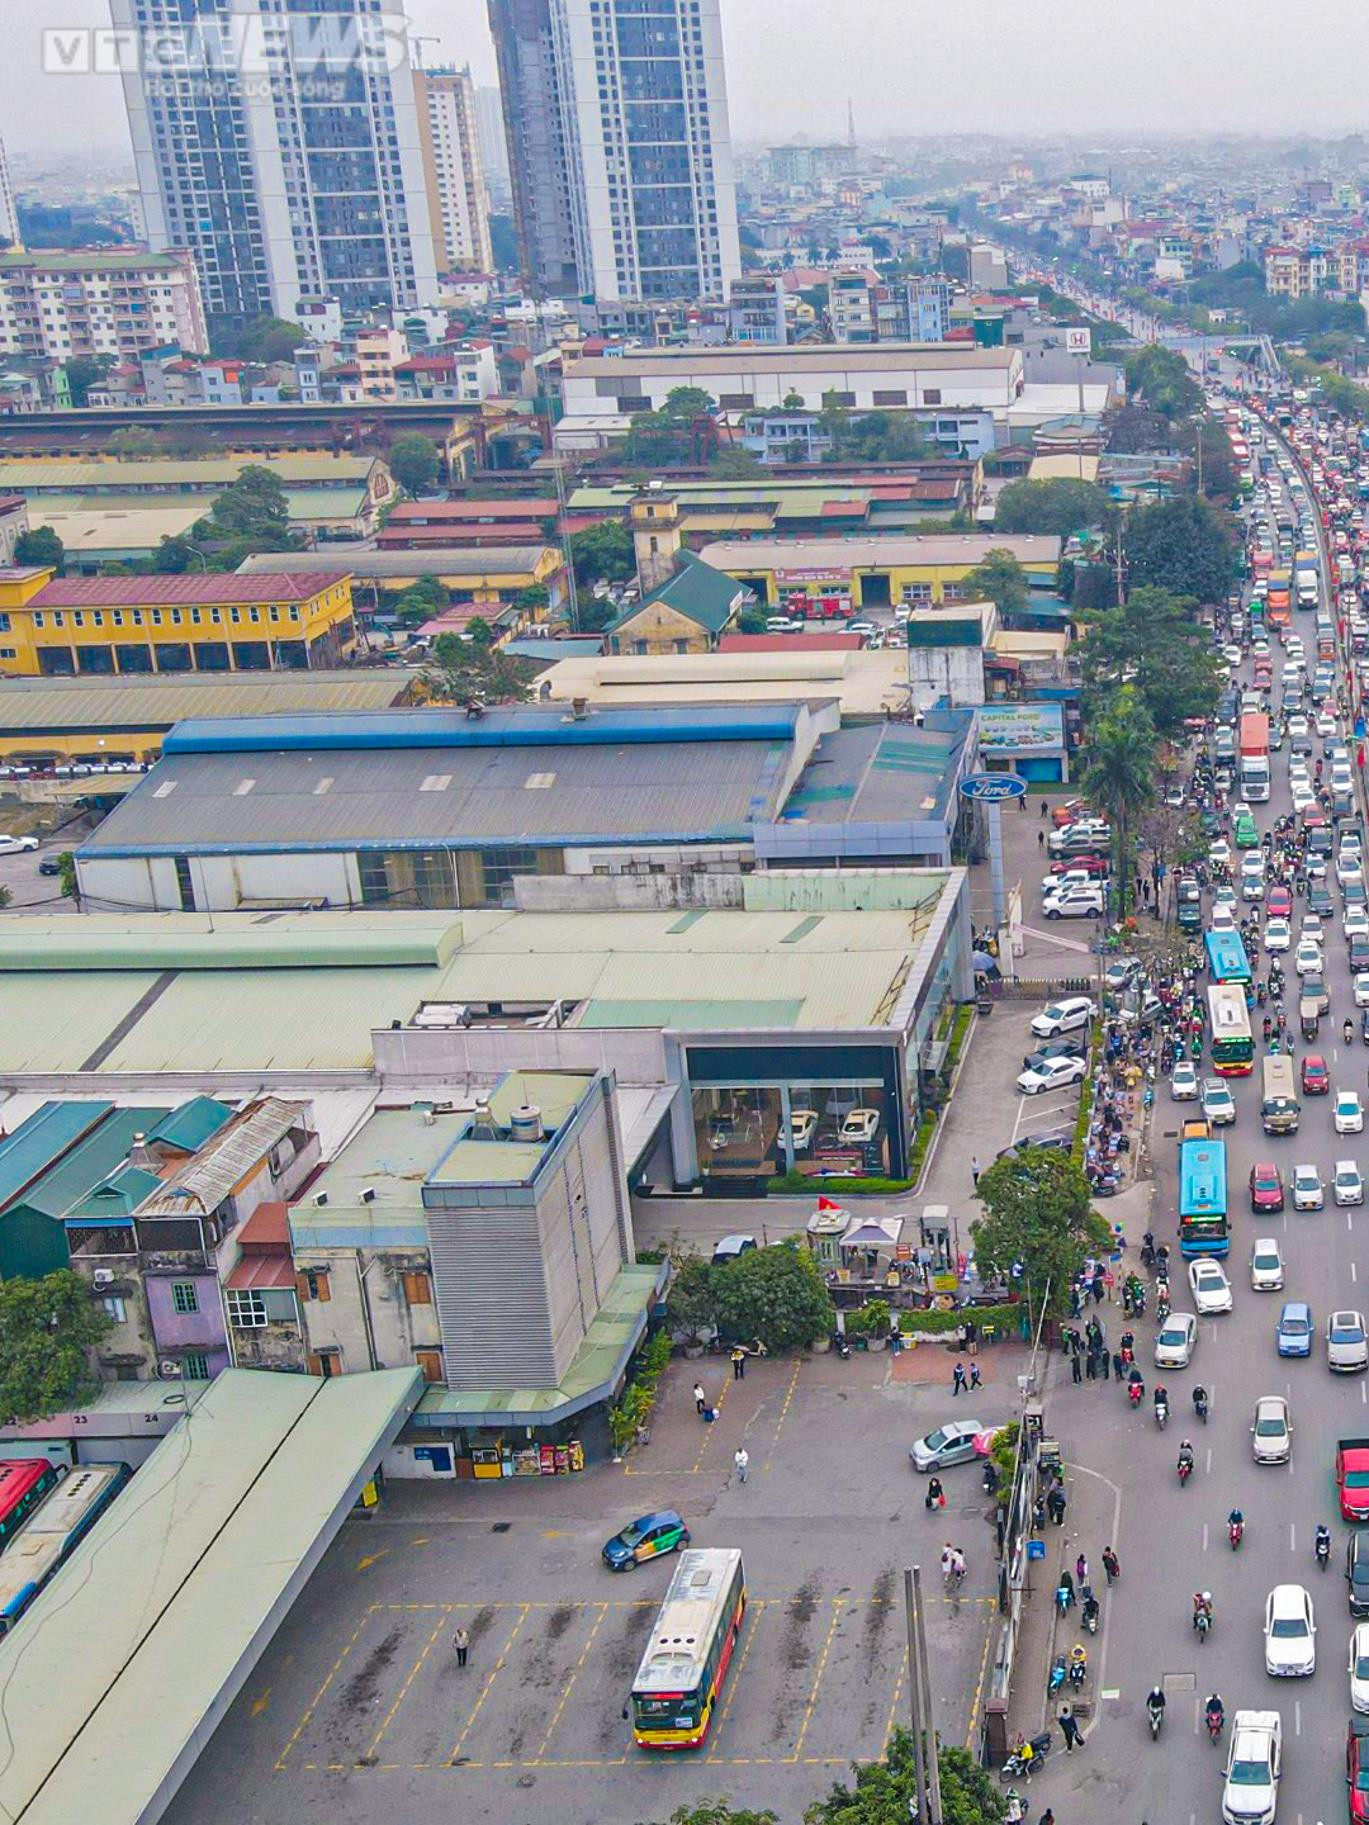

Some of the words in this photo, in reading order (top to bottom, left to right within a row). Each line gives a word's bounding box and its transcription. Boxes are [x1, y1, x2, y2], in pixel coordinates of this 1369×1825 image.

[972, 780, 1012, 796] Ford
[74, 1416, 88, 1424] 23
[145, 1415, 159, 1423] 24
